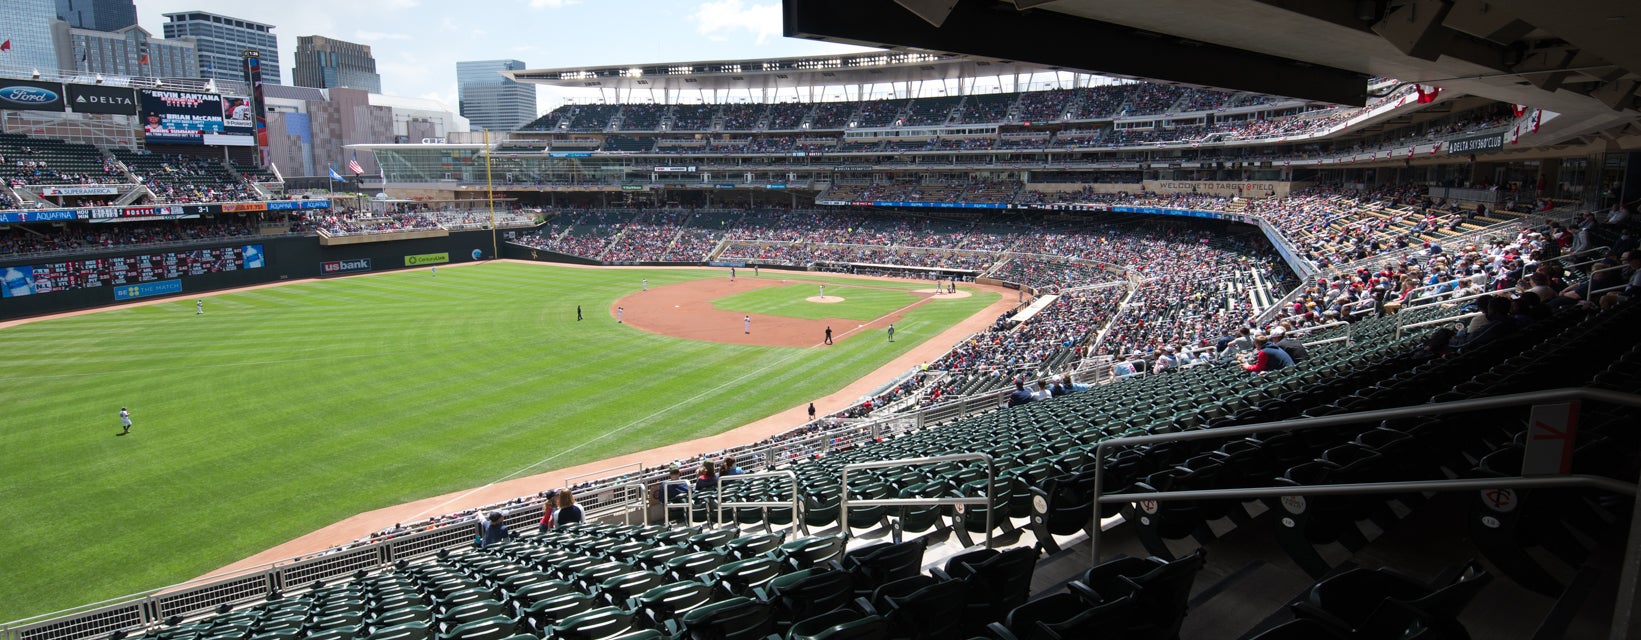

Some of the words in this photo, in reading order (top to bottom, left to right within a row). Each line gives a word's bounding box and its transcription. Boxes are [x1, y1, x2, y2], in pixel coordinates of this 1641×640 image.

[10, 89, 46, 102] Ford
[90, 95, 132, 105] DELTA
[152, 90, 179, 99] ERVIN
[180, 92, 220, 102] SANTANA
[166, 113, 191, 121] BRIAN
[192, 114, 222, 122] McCANN
[1453, 141, 1469, 152] DELTA
[1488, 136, 1502, 148] CLUB
[1160, 182, 1201, 190] WELCOME
[1216, 183, 1246, 191] TARGET
[36, 211, 73, 220] AQUAFINA
[417, 255, 446, 264] CenturyLink
[156, 283, 179, 291] MATCH
